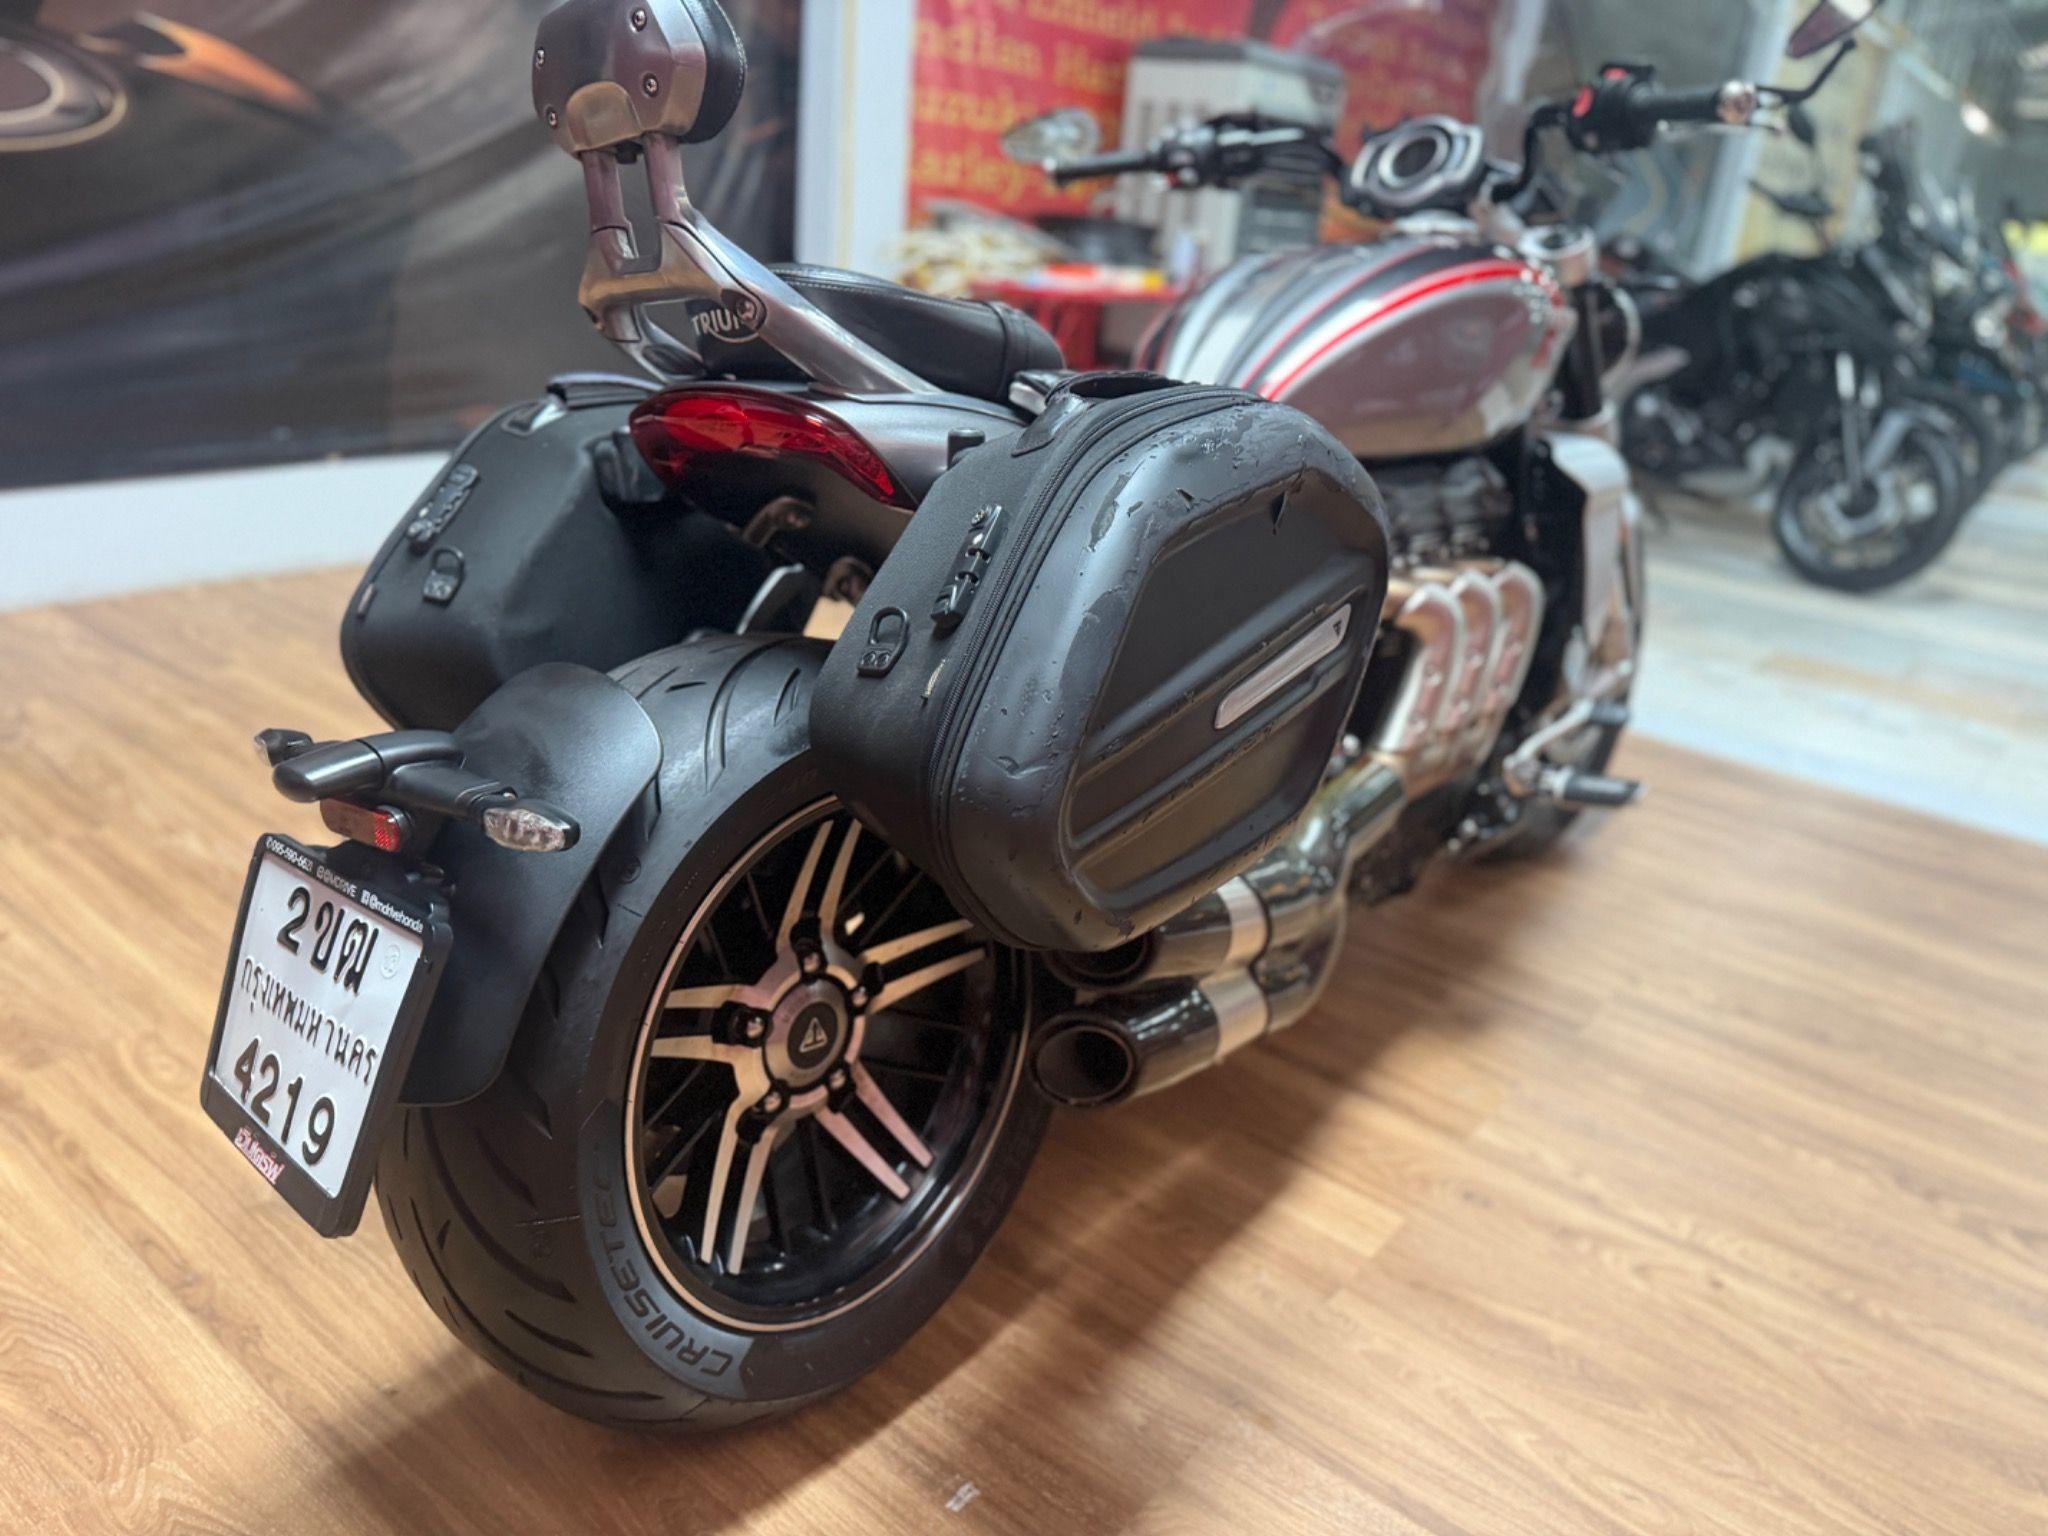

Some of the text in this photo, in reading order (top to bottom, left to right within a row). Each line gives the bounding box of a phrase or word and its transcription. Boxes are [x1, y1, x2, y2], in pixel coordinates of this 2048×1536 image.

[241, 957, 378, 1085] กรุงเทพมหานคร
[234, 1037, 335, 1165] 4219
